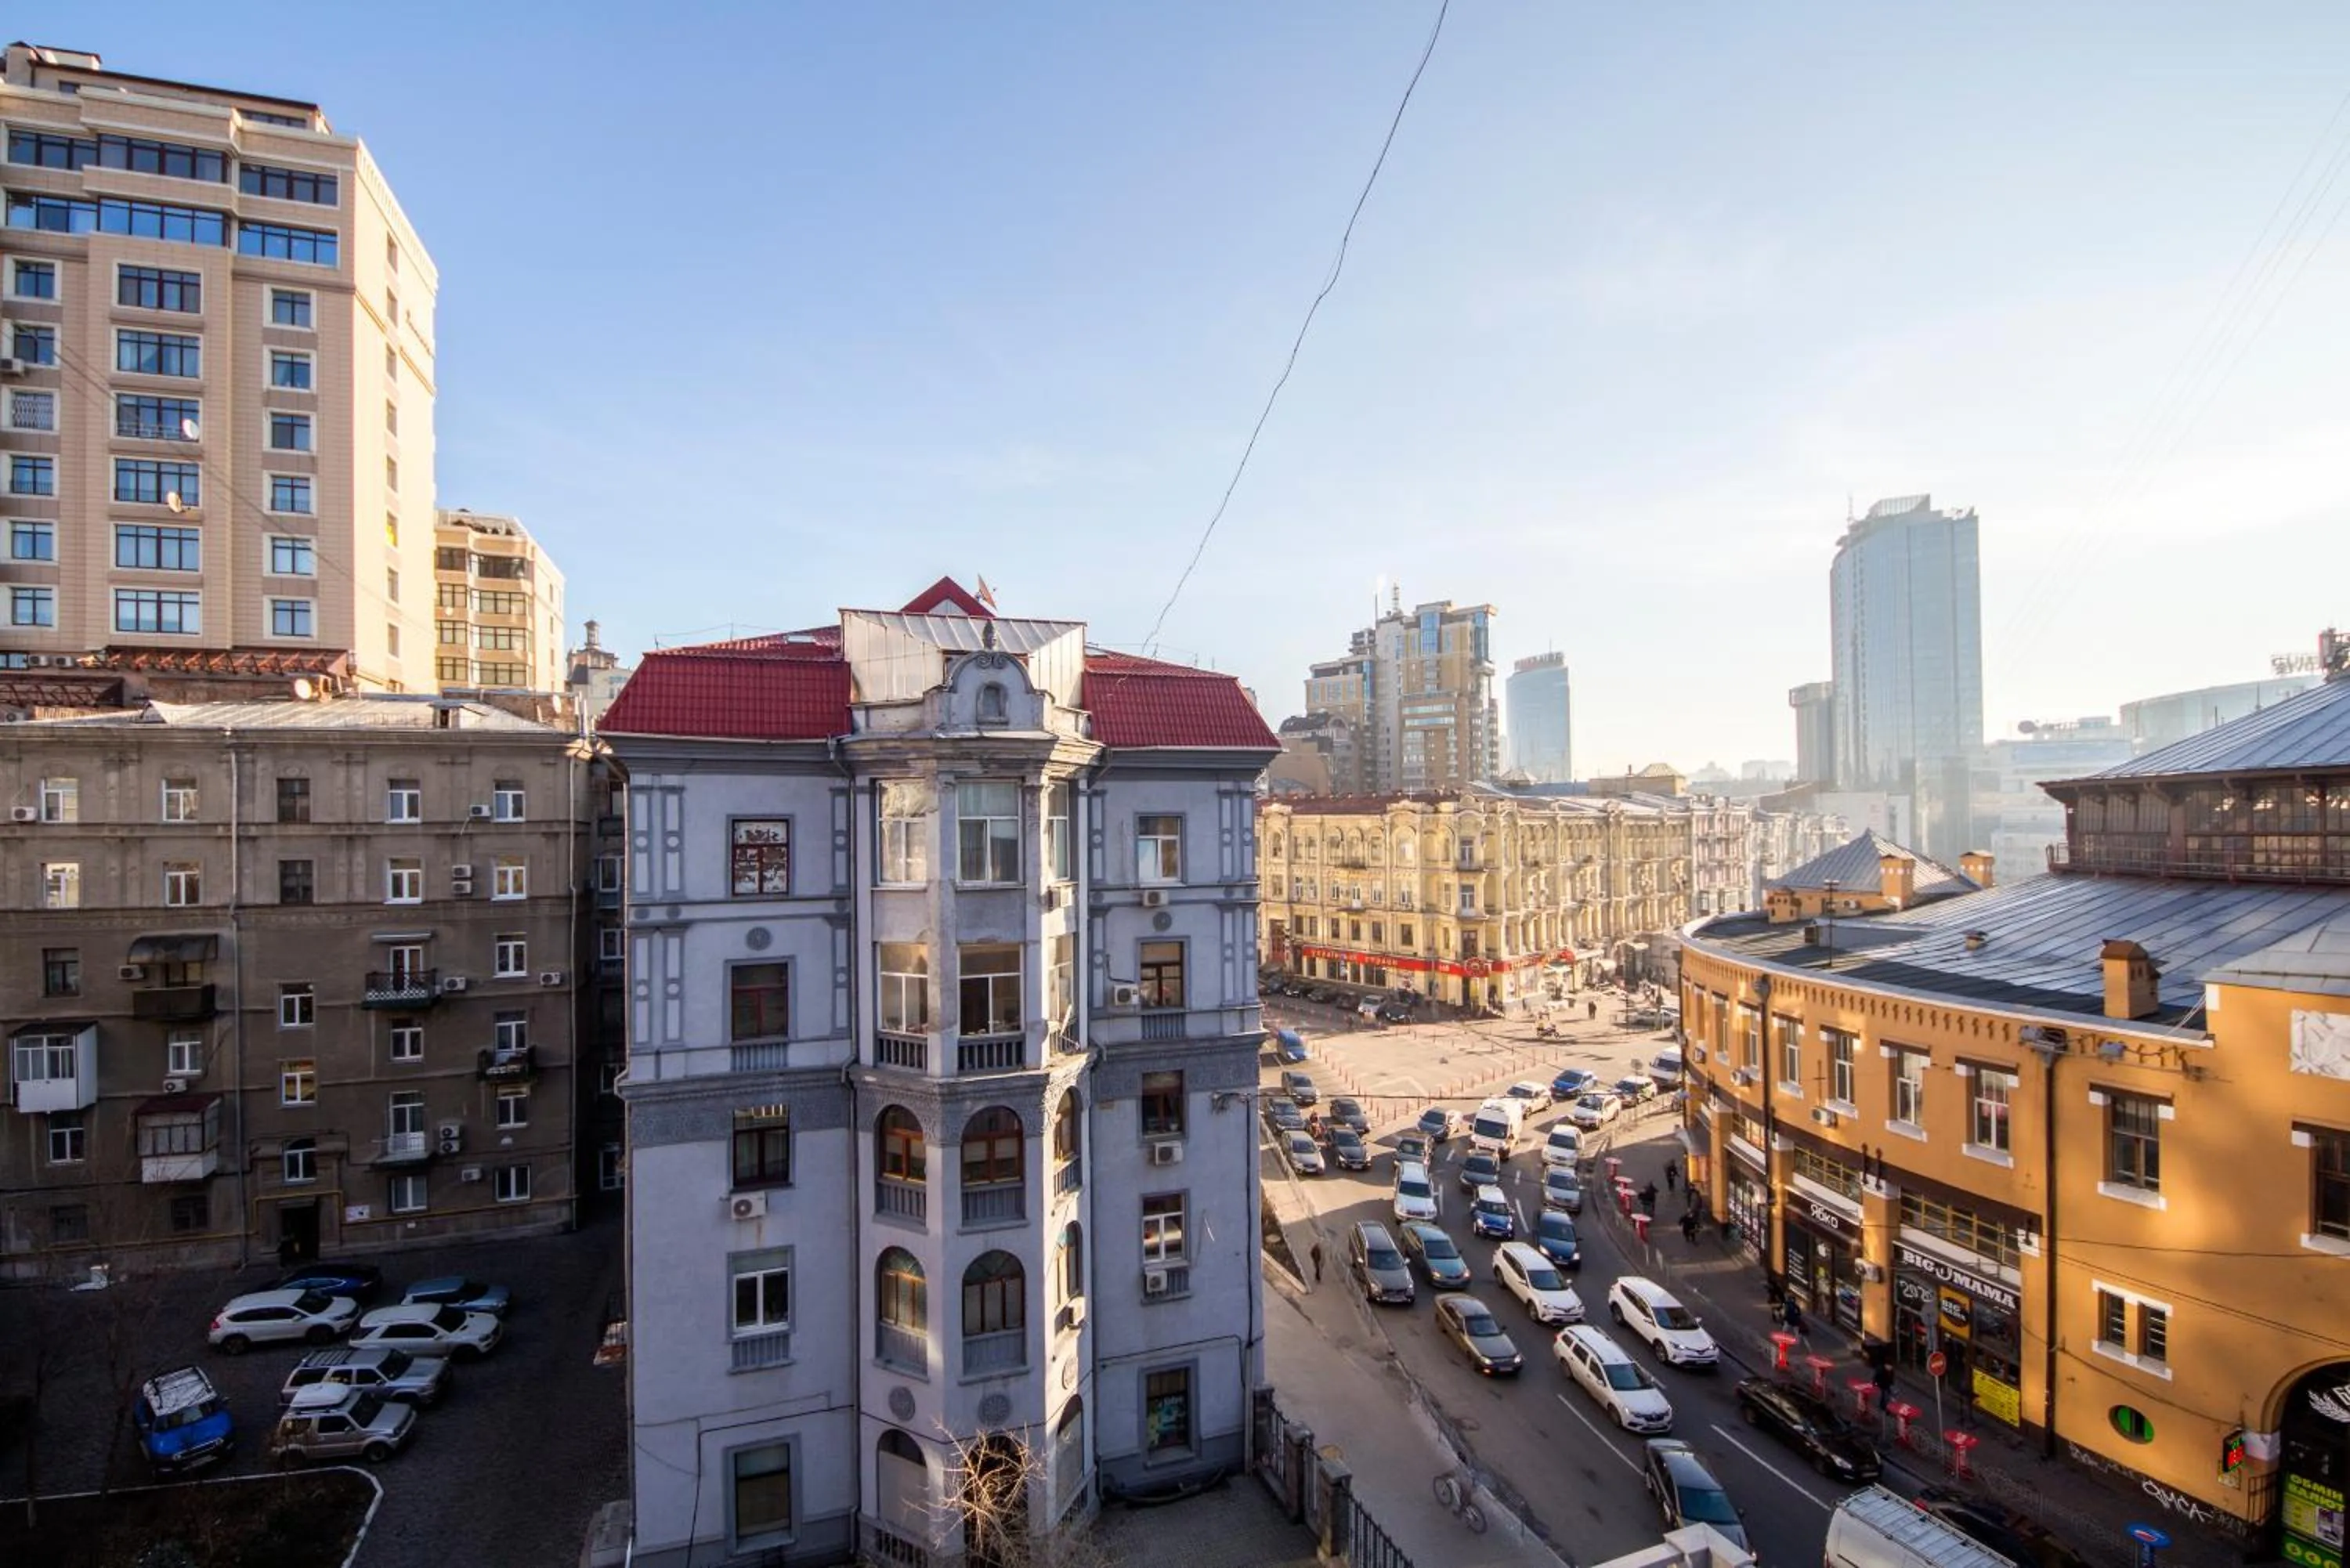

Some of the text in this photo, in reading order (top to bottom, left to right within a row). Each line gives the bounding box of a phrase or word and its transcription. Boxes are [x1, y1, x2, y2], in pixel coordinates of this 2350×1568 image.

[1903, 1249, 2016, 1310] BIG MAMA
[2287, 1483, 2345, 1512] ВАЛЮТ
[2290, 1474, 2343, 1502] ОБМІН
